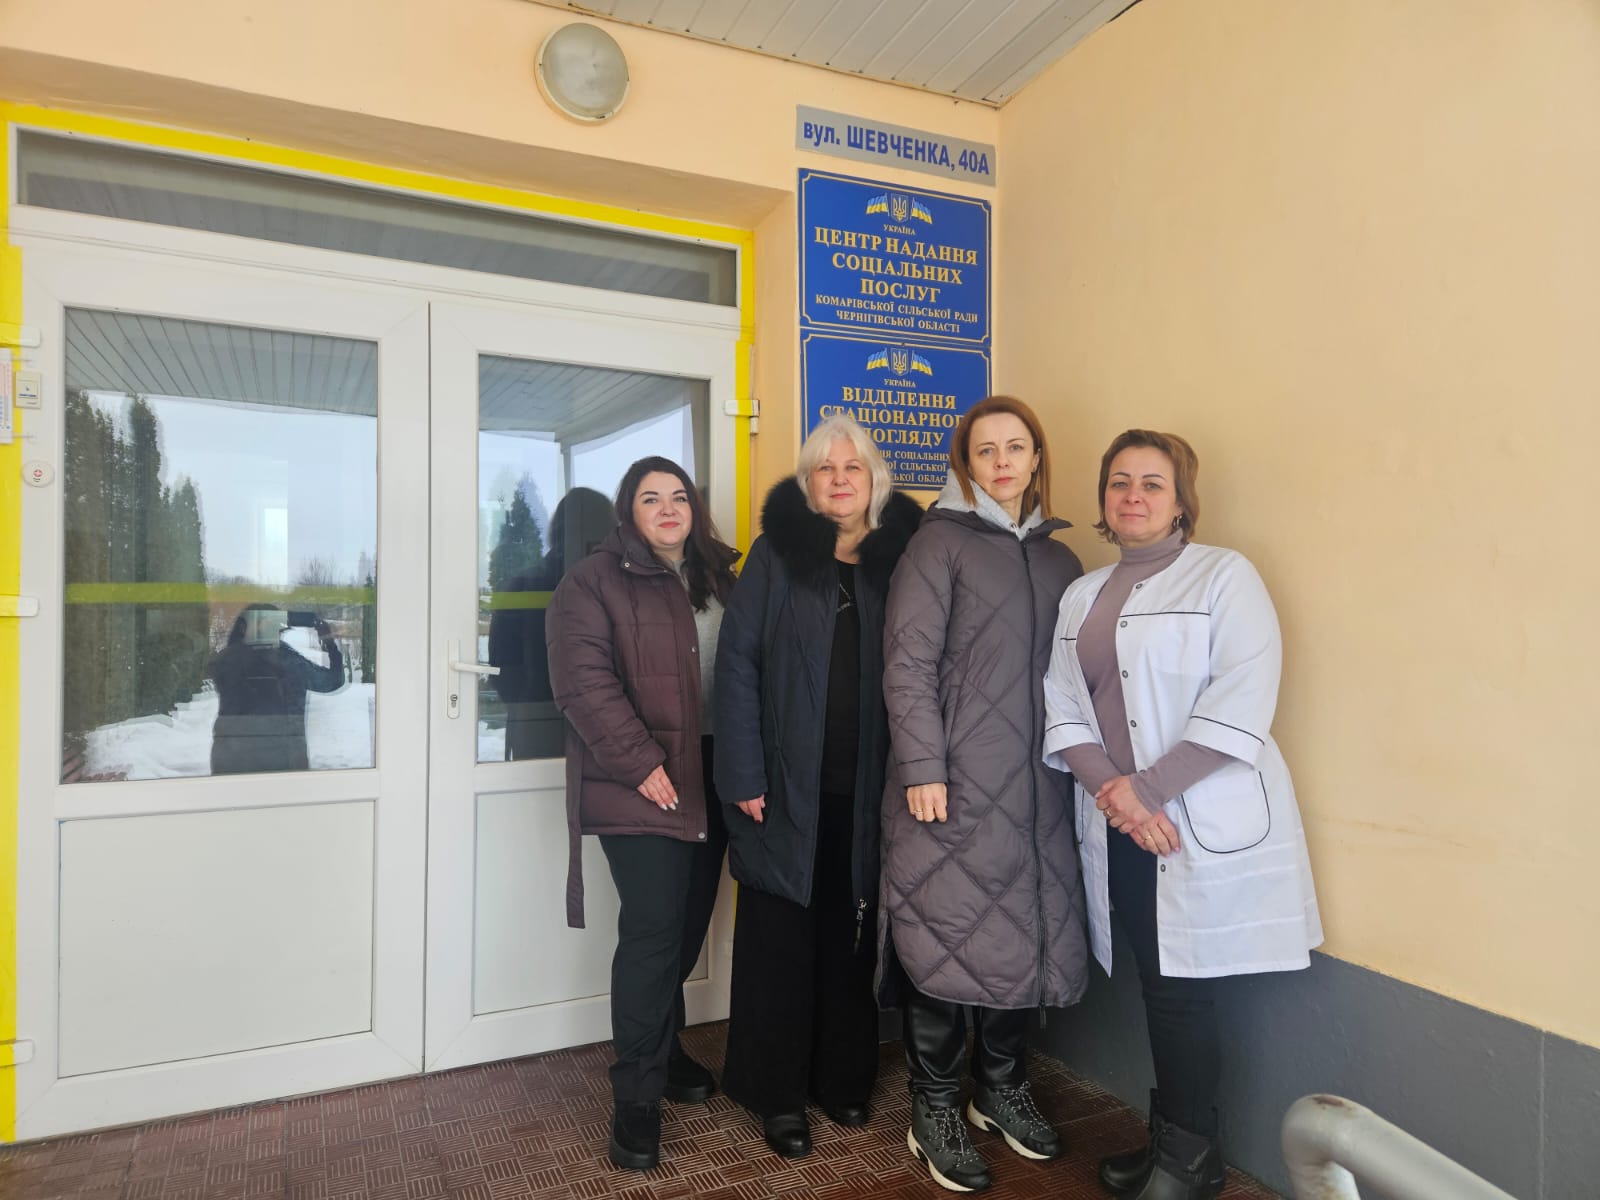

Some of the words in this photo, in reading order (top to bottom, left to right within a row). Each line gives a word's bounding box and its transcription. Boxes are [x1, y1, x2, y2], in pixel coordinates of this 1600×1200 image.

[803, 121, 841, 147] вул.
[847, 124, 955, 171] ШЕВЧЕНКА,
[958, 149, 990, 175] 40А
[883, 223, 916, 236] УКРАЇНА
[814, 226, 882, 251] ЦЕНТР
[885, 236, 978, 266] НАДАННЯ
[832, 252, 963, 285] СОЦІАЛЬНИХ
[860, 278, 941, 303] ПОСЛУГ
[815, 294, 895, 312] КОМАРІВСЬКОЇ
[897, 304, 951, 321] СІЛЬСЬКОЇ
[954, 311, 978, 323] РАДИ
[836, 310, 915, 328] ЧЕРНІГІВСЬКОЇ
[918, 319, 960, 333] ОБЛАСТІ
[883, 378, 916, 388] УКРАЇНА
[842, 386, 957, 410] ВІДДІЛЕННЯ
[819, 404, 965, 428] СТАЦІОНАРНОГ
[900, 462, 947, 472] СІЛЬСЬКОЇ
[917, 474, 947, 483] ОБЛАС
